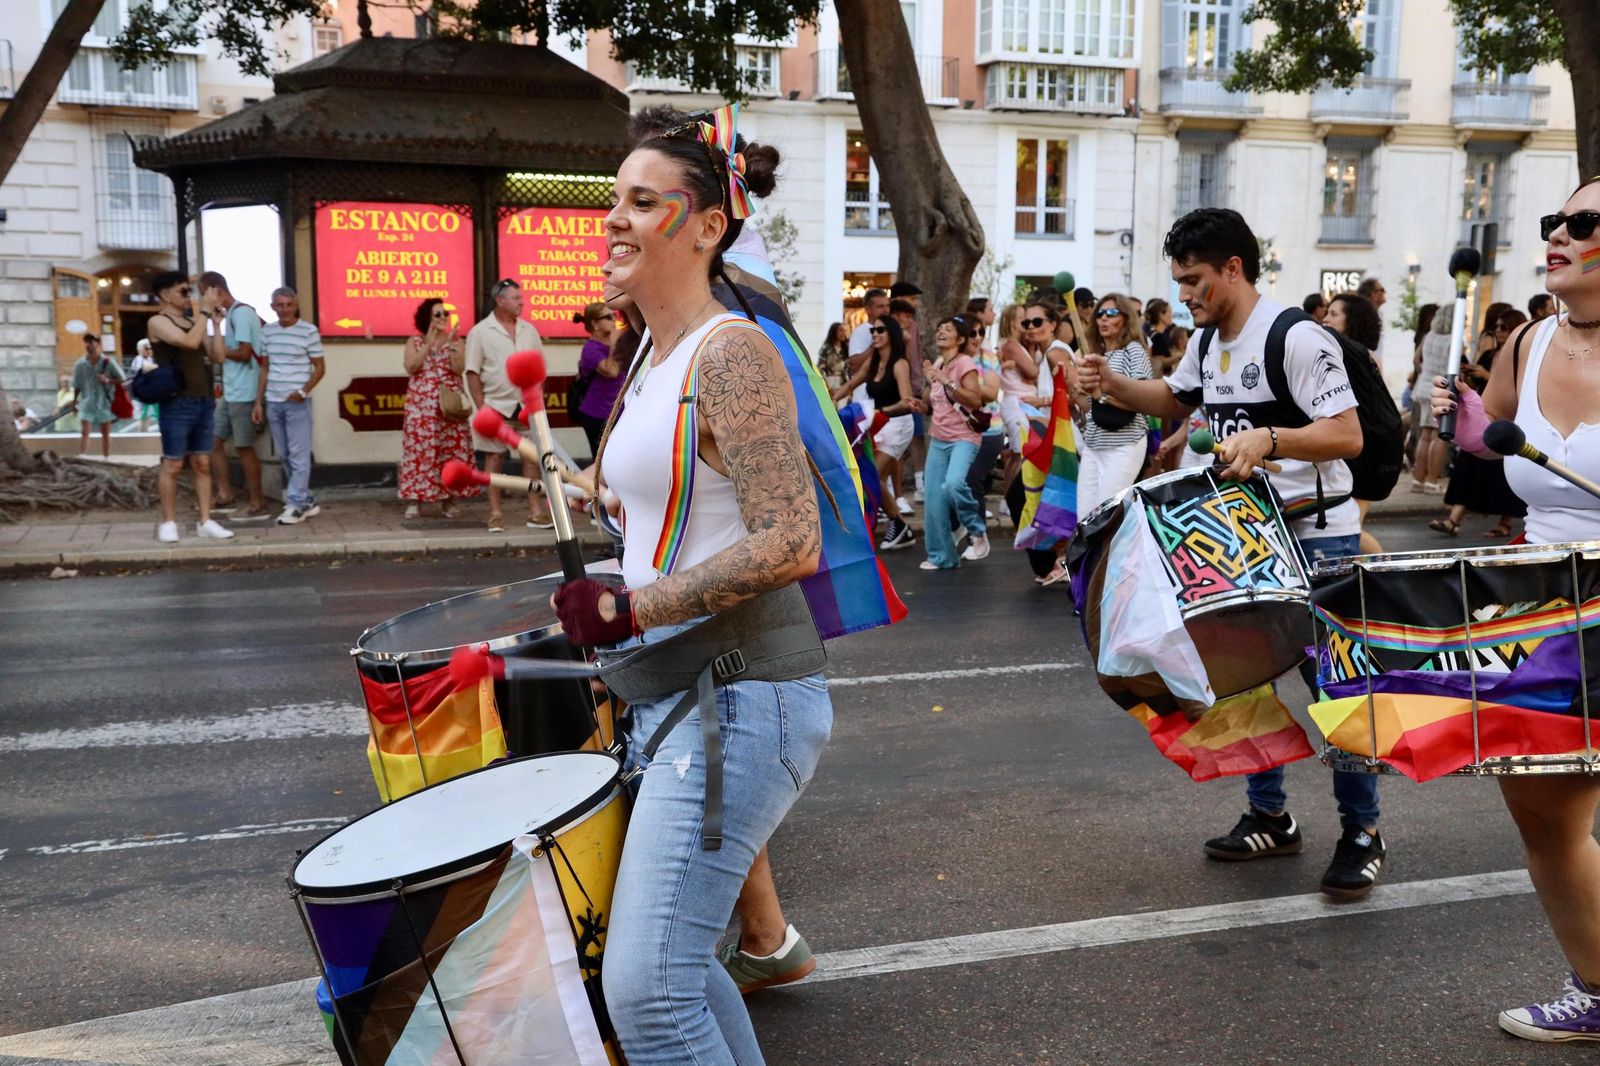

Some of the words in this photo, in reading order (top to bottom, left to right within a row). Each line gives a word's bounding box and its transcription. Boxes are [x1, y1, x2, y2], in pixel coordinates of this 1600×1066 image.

[329, 208, 460, 233] ESTANCO
[506, 214, 607, 237] ALAMED
[573, 238, 585, 246] 24
[354, 250, 439, 267] ABIERTO
[538, 250, 599, 262] TABACOS
[519, 264, 576, 276] BEBIDAS
[346, 269, 374, 284] DE
[377, 269, 390, 284] 9
[394, 269, 408, 284] A
[411, 269, 448, 285] 21H
[521, 279, 586, 292] TARJETAS
[346, 289, 360, 298] DE
[363, 289, 398, 298] LUNES
[400, 289, 407, 298] A
[531, 308, 573, 320] SOUVE
